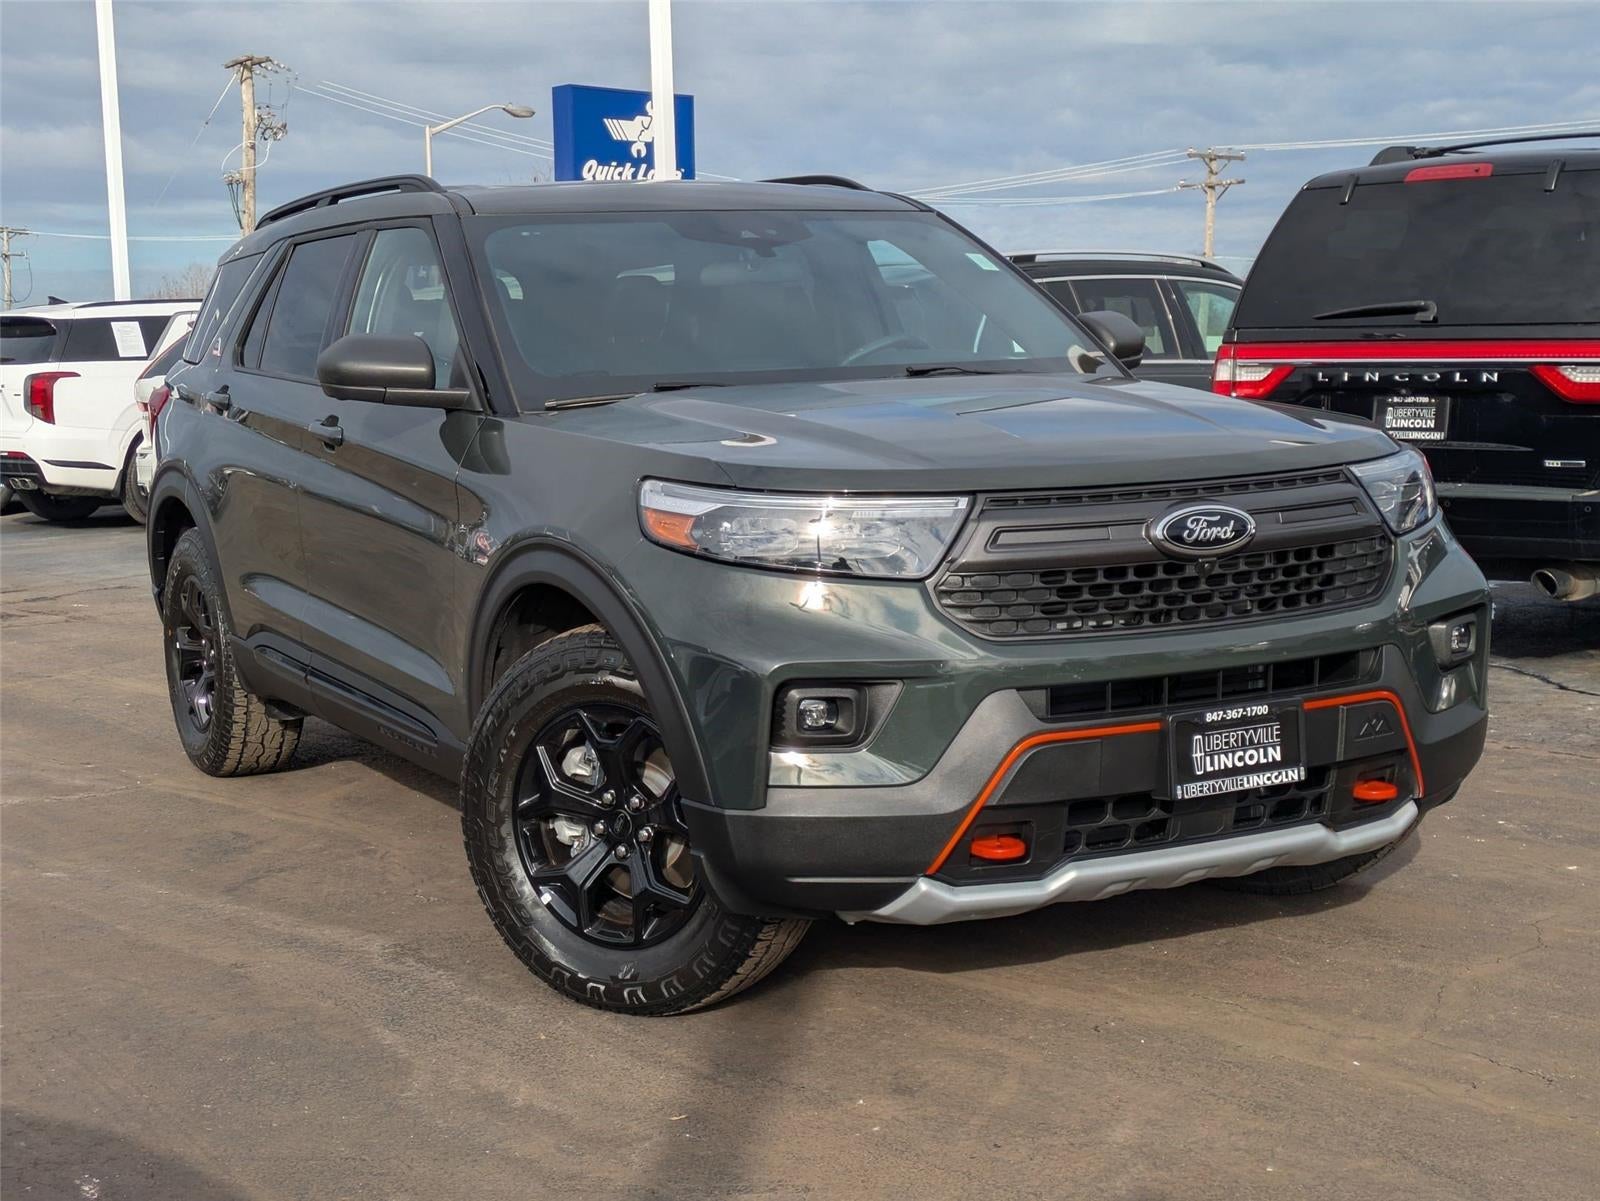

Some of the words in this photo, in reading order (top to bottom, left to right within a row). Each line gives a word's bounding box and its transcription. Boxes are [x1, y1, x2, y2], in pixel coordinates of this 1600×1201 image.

[582, 159, 636, 180] Quick
[1317, 371, 1499, 383] LINCOLN
[1394, 408, 1436, 418] LIBERTYVILLE
[1392, 419, 1435, 428] LINCOLN
[1184, 515, 1235, 543] Ford
[1206, 705, 1269, 722] 847-367-1700
[1205, 725, 1281, 752] LIBERTYVILLE
[1205, 745, 1282, 773] LINCOLN
